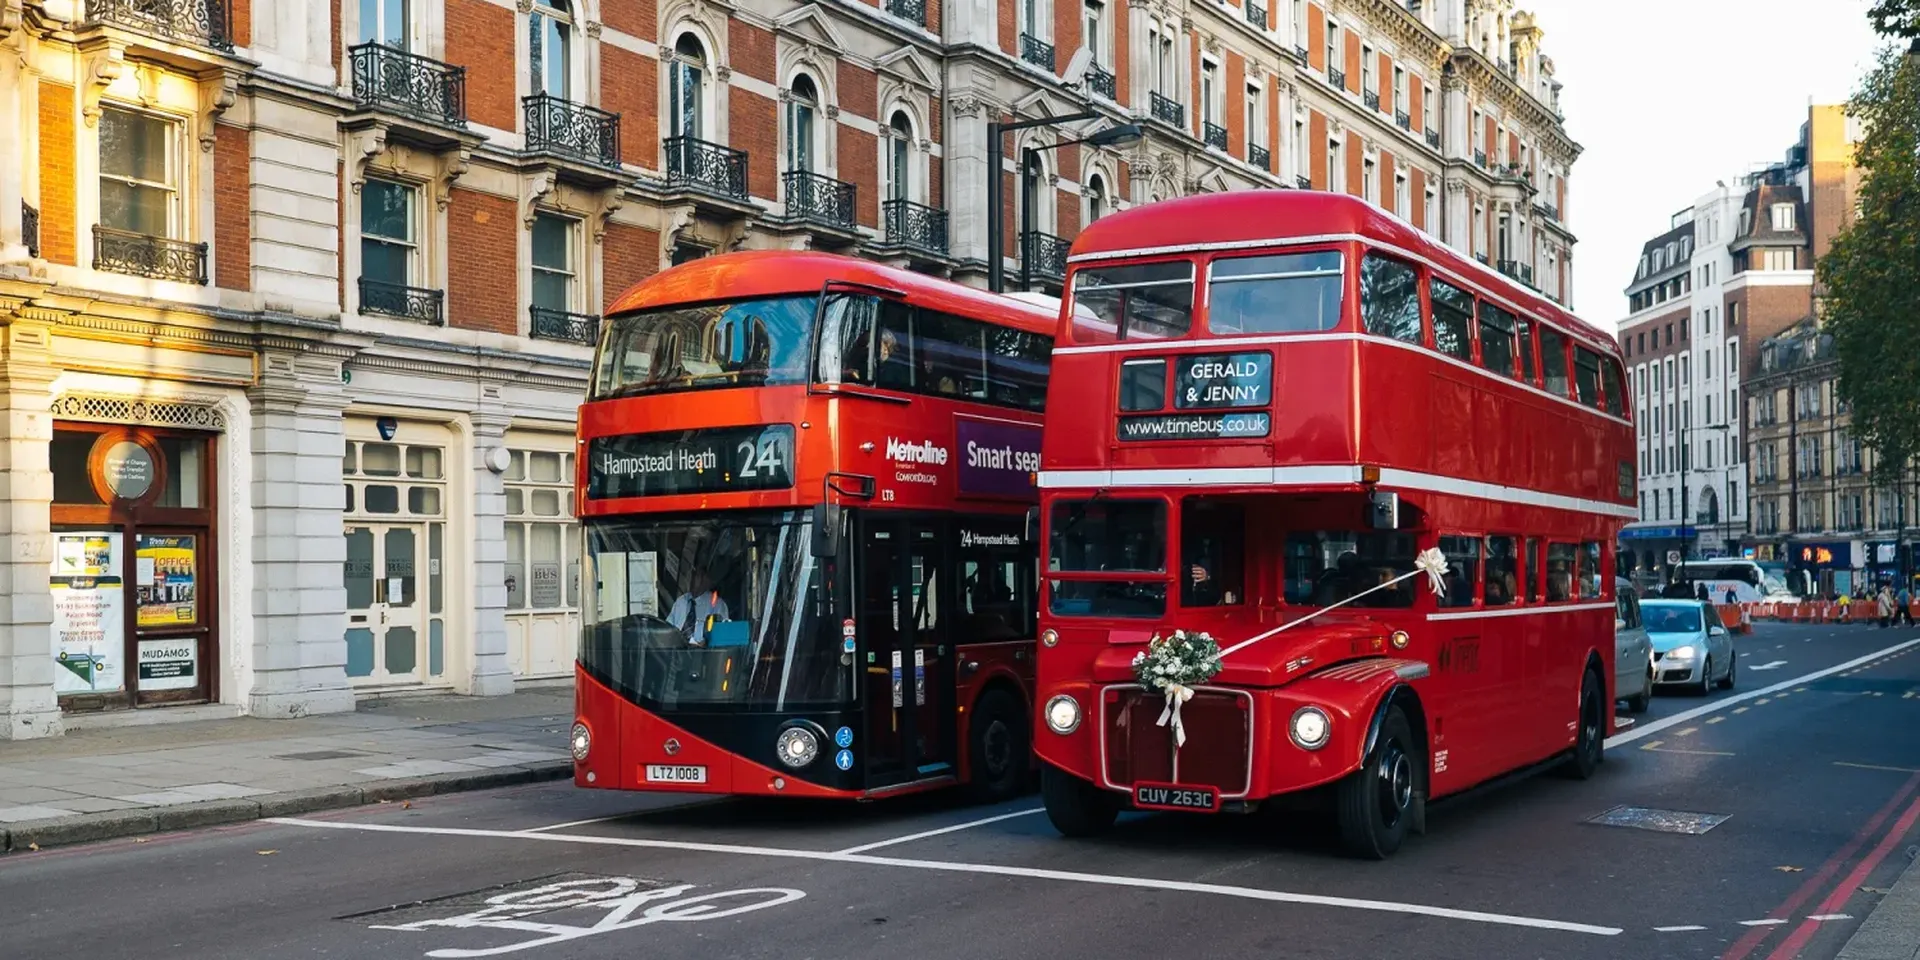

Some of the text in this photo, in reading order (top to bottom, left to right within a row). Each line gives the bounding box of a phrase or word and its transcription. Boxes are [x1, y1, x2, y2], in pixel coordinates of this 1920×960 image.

[1190, 362, 1258, 378] GERALD
[1186, 385, 1260, 402] & JENNY
[1125, 415, 1266, 435] www.timebus.co.uk
[603, 439, 781, 479] Hampstead Heath 24
[885, 436, 948, 465] Metroline
[967, 440, 1012, 470] Smart
[881, 489, 895, 501] LT8
[960, 530, 1020, 547] 24 Hampstead Heath
[159, 557, 191, 567] OFFICE
[534, 570, 558, 580] BUS
[1139, 788, 1212, 807] CUV 263C
